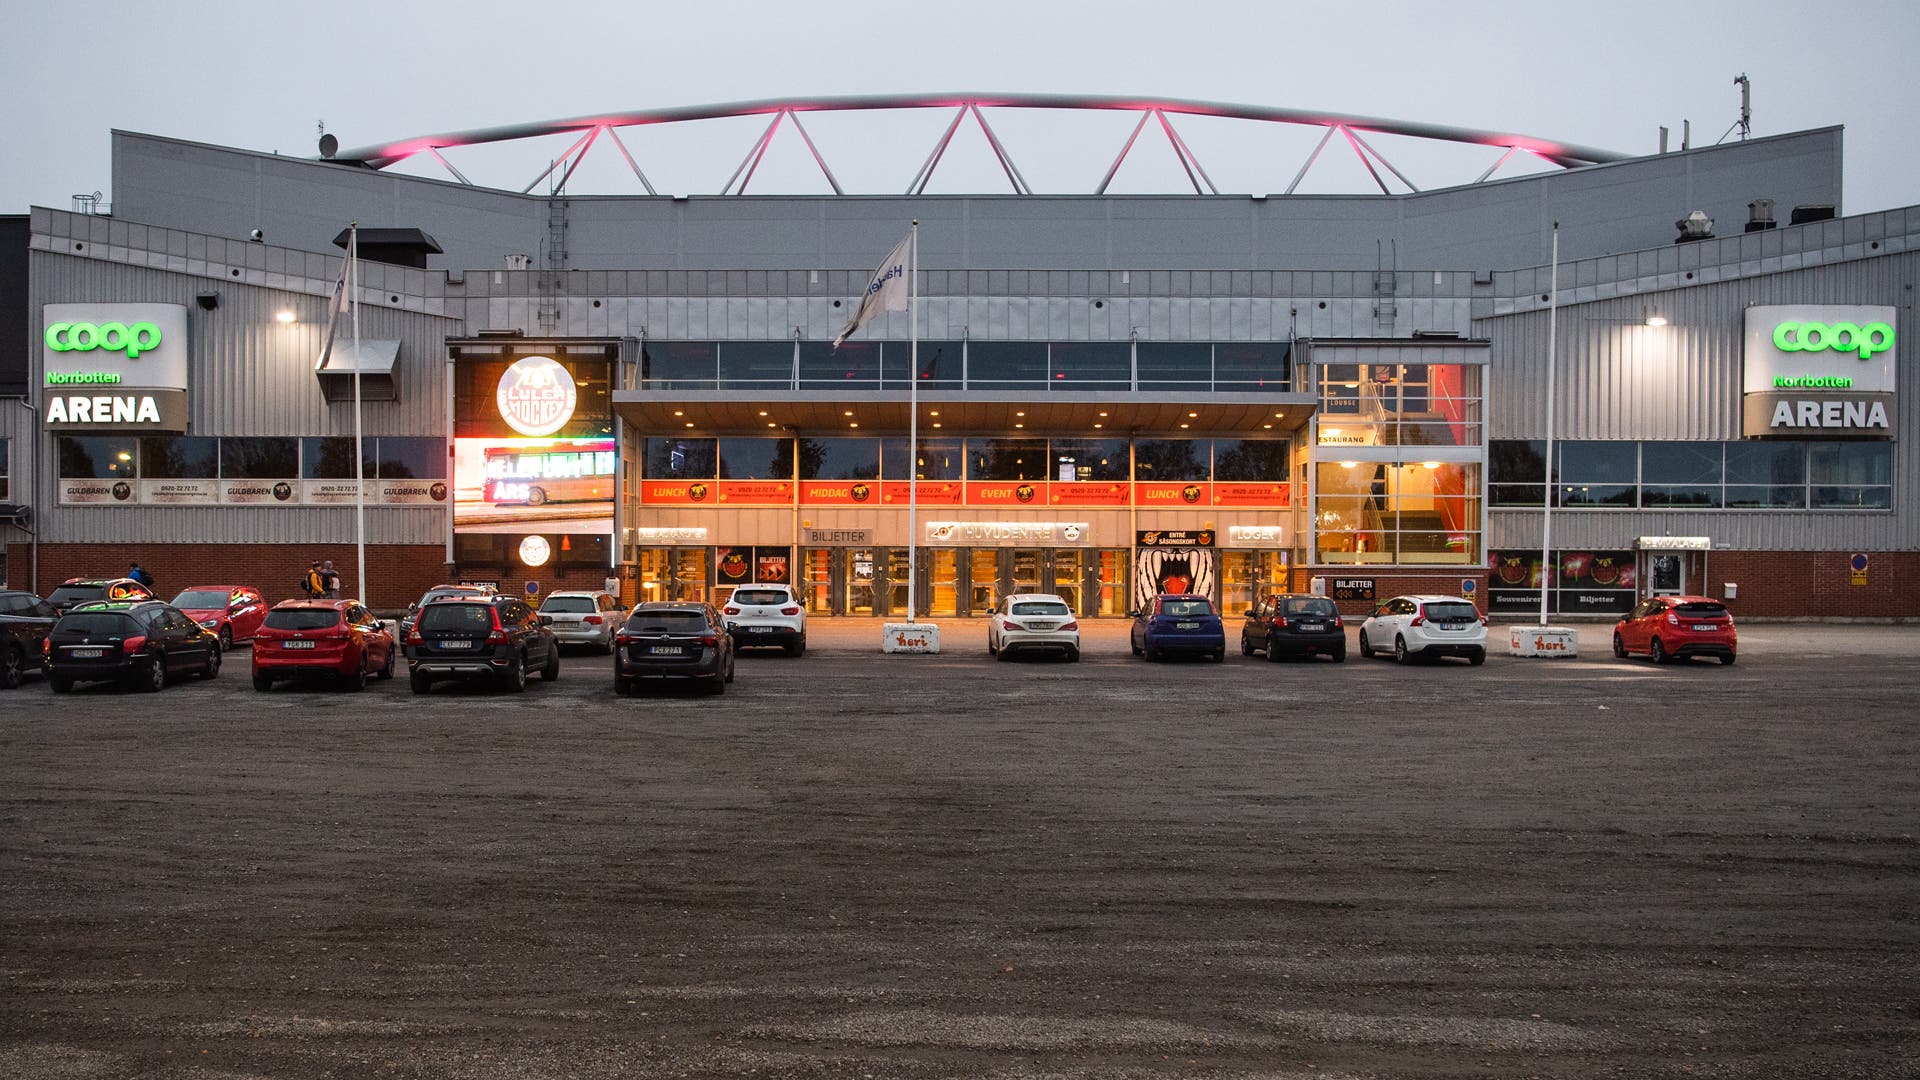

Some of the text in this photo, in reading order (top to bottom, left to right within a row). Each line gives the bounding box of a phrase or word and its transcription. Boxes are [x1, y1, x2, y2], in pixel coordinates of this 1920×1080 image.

[45, 322, 162, 358] coop
[1772, 322, 1895, 359] coop
[47, 371, 121, 383] Norrbotten
[1773, 375, 1853, 388] Norrbotten
[47, 397, 160, 422] ARENA
[509, 400, 564, 424] HOCKEY
[1771, 401, 1889, 428] ARENA
[653, 488, 685, 496] LUNCH
[810, 489, 848, 497] MIDDAG
[981, 489, 1012, 498] EVENT
[1146, 490, 1178, 498] LUNCH
[812, 532, 864, 541] BILJETTER
[1580, 596, 1615, 604] Biljetter
